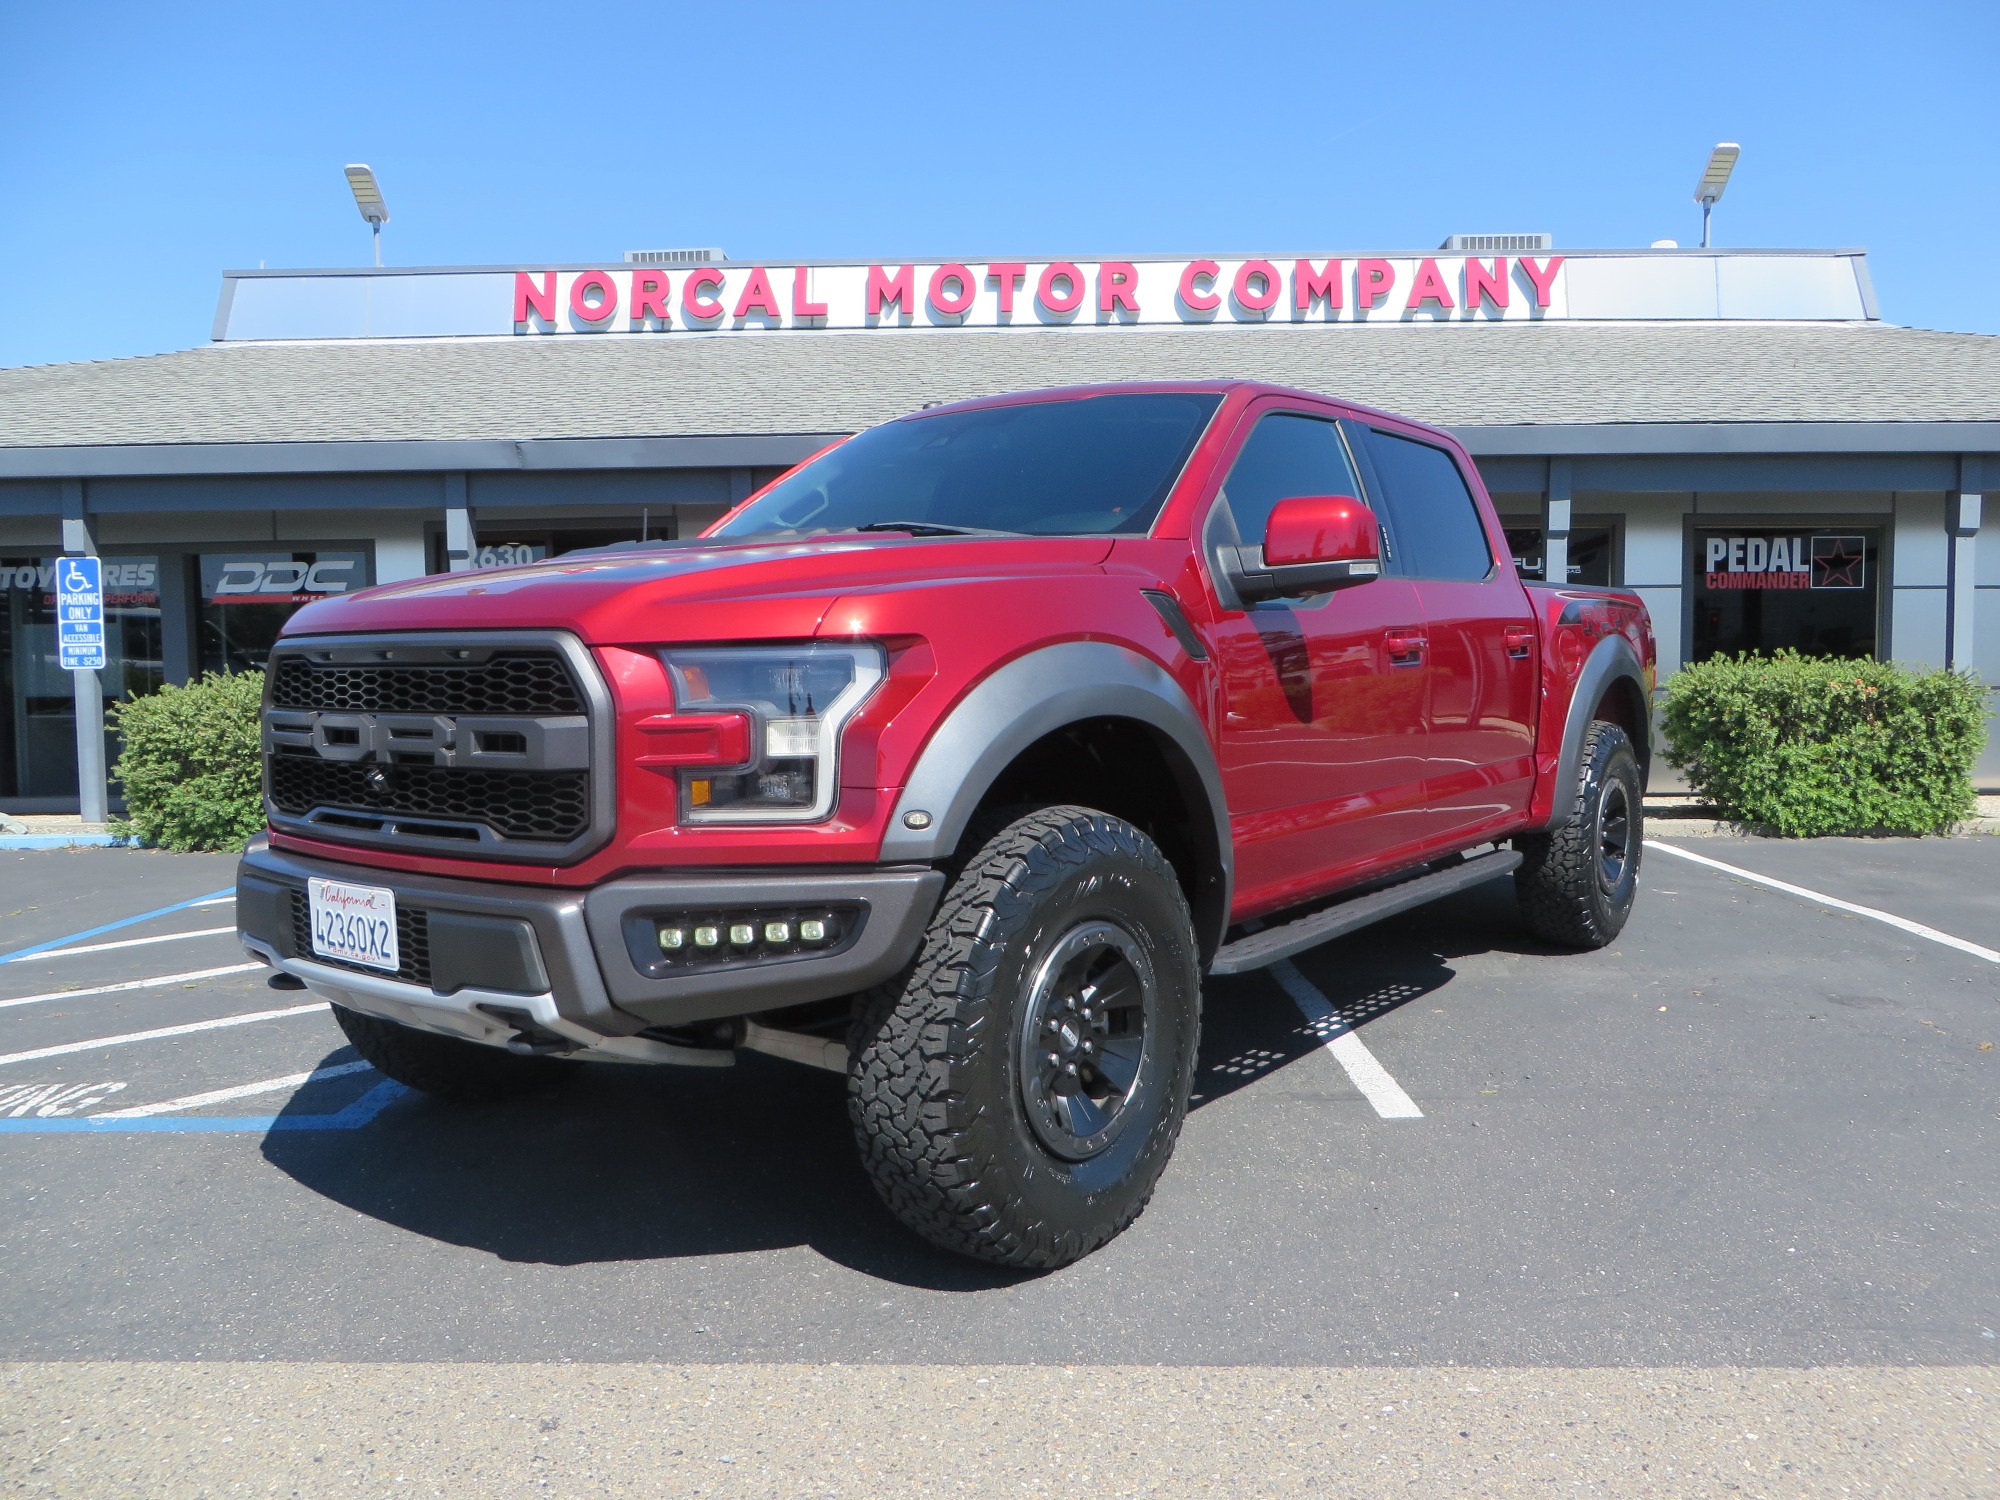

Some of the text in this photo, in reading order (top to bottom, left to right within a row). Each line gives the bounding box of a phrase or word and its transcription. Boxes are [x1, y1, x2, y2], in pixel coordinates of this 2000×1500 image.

[514, 257, 1566, 324] NORCAL MOTOR COMPANY
[1706, 537, 1810, 572] PEDAL
[0, 566, 56, 588] TOY
[215, 560, 355, 593] DDC
[1706, 571, 1810, 589] COMMANDER
[60, 592, 99, 606] PARKING
[68, 606, 93, 620] ONLY
[63, 633, 101, 643] ACCESSIBLE
[74, 624, 89, 632] VAN
[68, 646, 97, 655] MINIMUM
[63, 656, 102, 666] FINE $250
[262, 710, 560, 769] FORD
[325, 885, 378, 910] California
[316, 908, 391, 960] 42360X2
